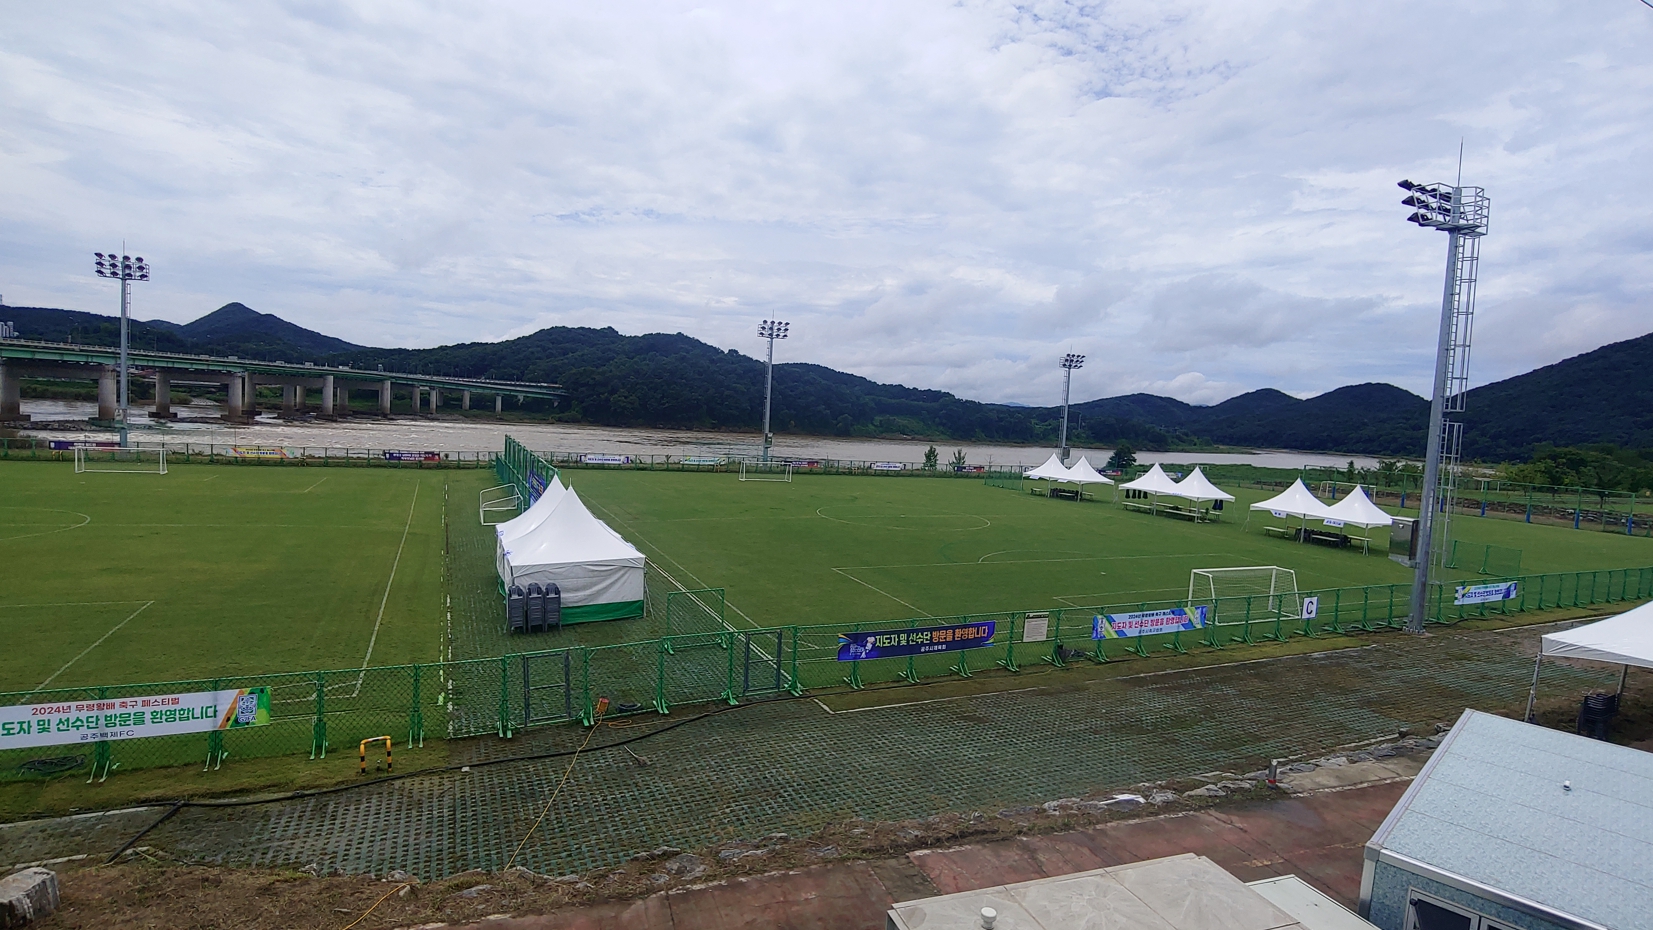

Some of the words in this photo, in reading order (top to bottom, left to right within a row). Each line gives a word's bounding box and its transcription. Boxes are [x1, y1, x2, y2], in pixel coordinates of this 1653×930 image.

[1306, 601, 1314, 615] C
[1111, 621, 1127, 630] 지도자
[1134, 620, 1149, 629] 선수단
[875, 634, 899, 647] 지도자
[899, 633, 908, 646] 및
[909, 631, 931, 645] 선수단
[932, 629, 953, 643] 방문을
[954, 626, 988, 641] 환영합니다
[31, 705, 72, 716] 2024년
[75, 702, 116, 713] 무령왕배
[119, 700, 138, 709] 축구
[141, 697, 180, 708] 페스티벌
[1, 720, 32, 736] 도자
[37, 718, 52, 734] 및
[56, 715, 100, 732] 선수단
[104, 711, 146, 728] 방문을
[150, 705, 218, 724] 환영합니다
[80, 730, 135, 741] 공주백제FC
